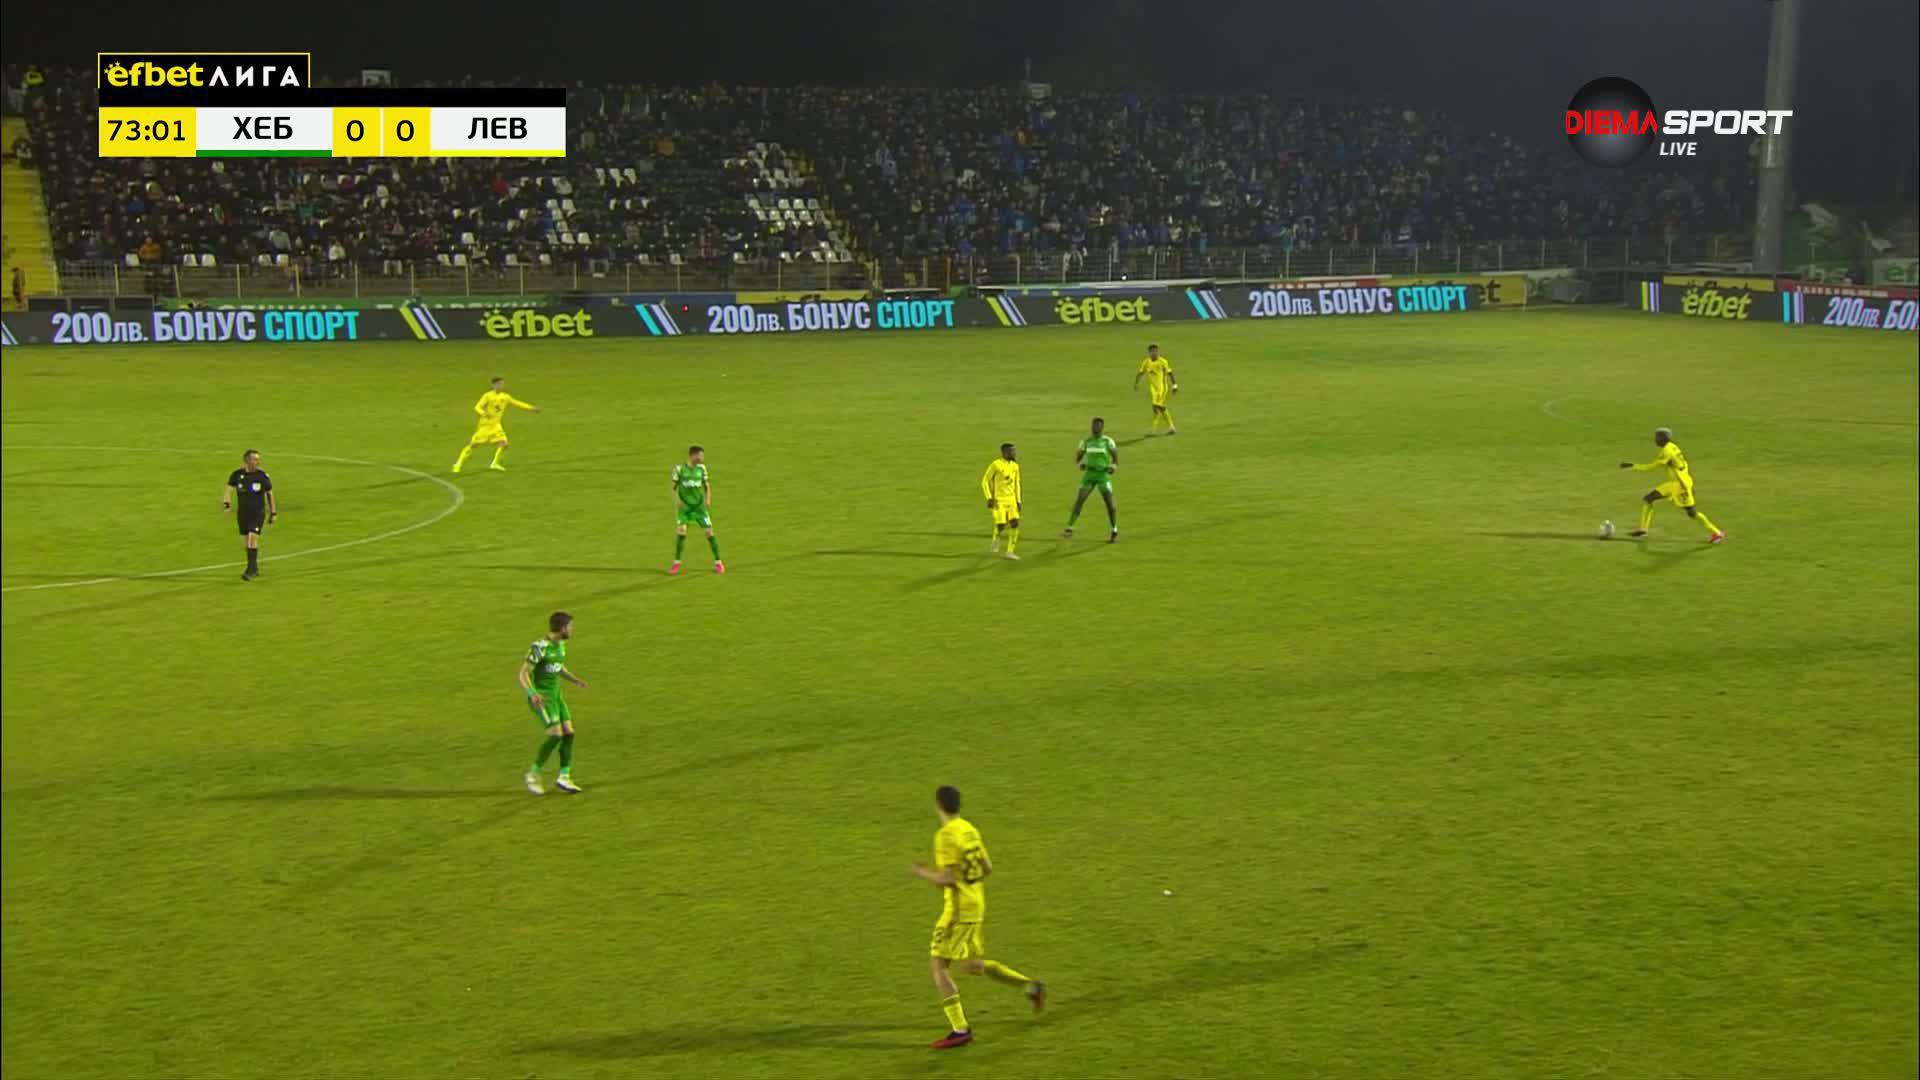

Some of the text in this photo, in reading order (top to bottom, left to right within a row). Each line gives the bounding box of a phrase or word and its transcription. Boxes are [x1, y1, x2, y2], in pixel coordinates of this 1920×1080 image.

[788, 302, 871, 332] БОНУС
[876, 299, 955, 329] СПОРТ
[1319, 287, 1393, 315] БОНУС
[1397, 285, 1468, 313] СПОРТ
[153, 310, 257, 342] БОНУС
[264, 310, 360, 341] СПОРТ
